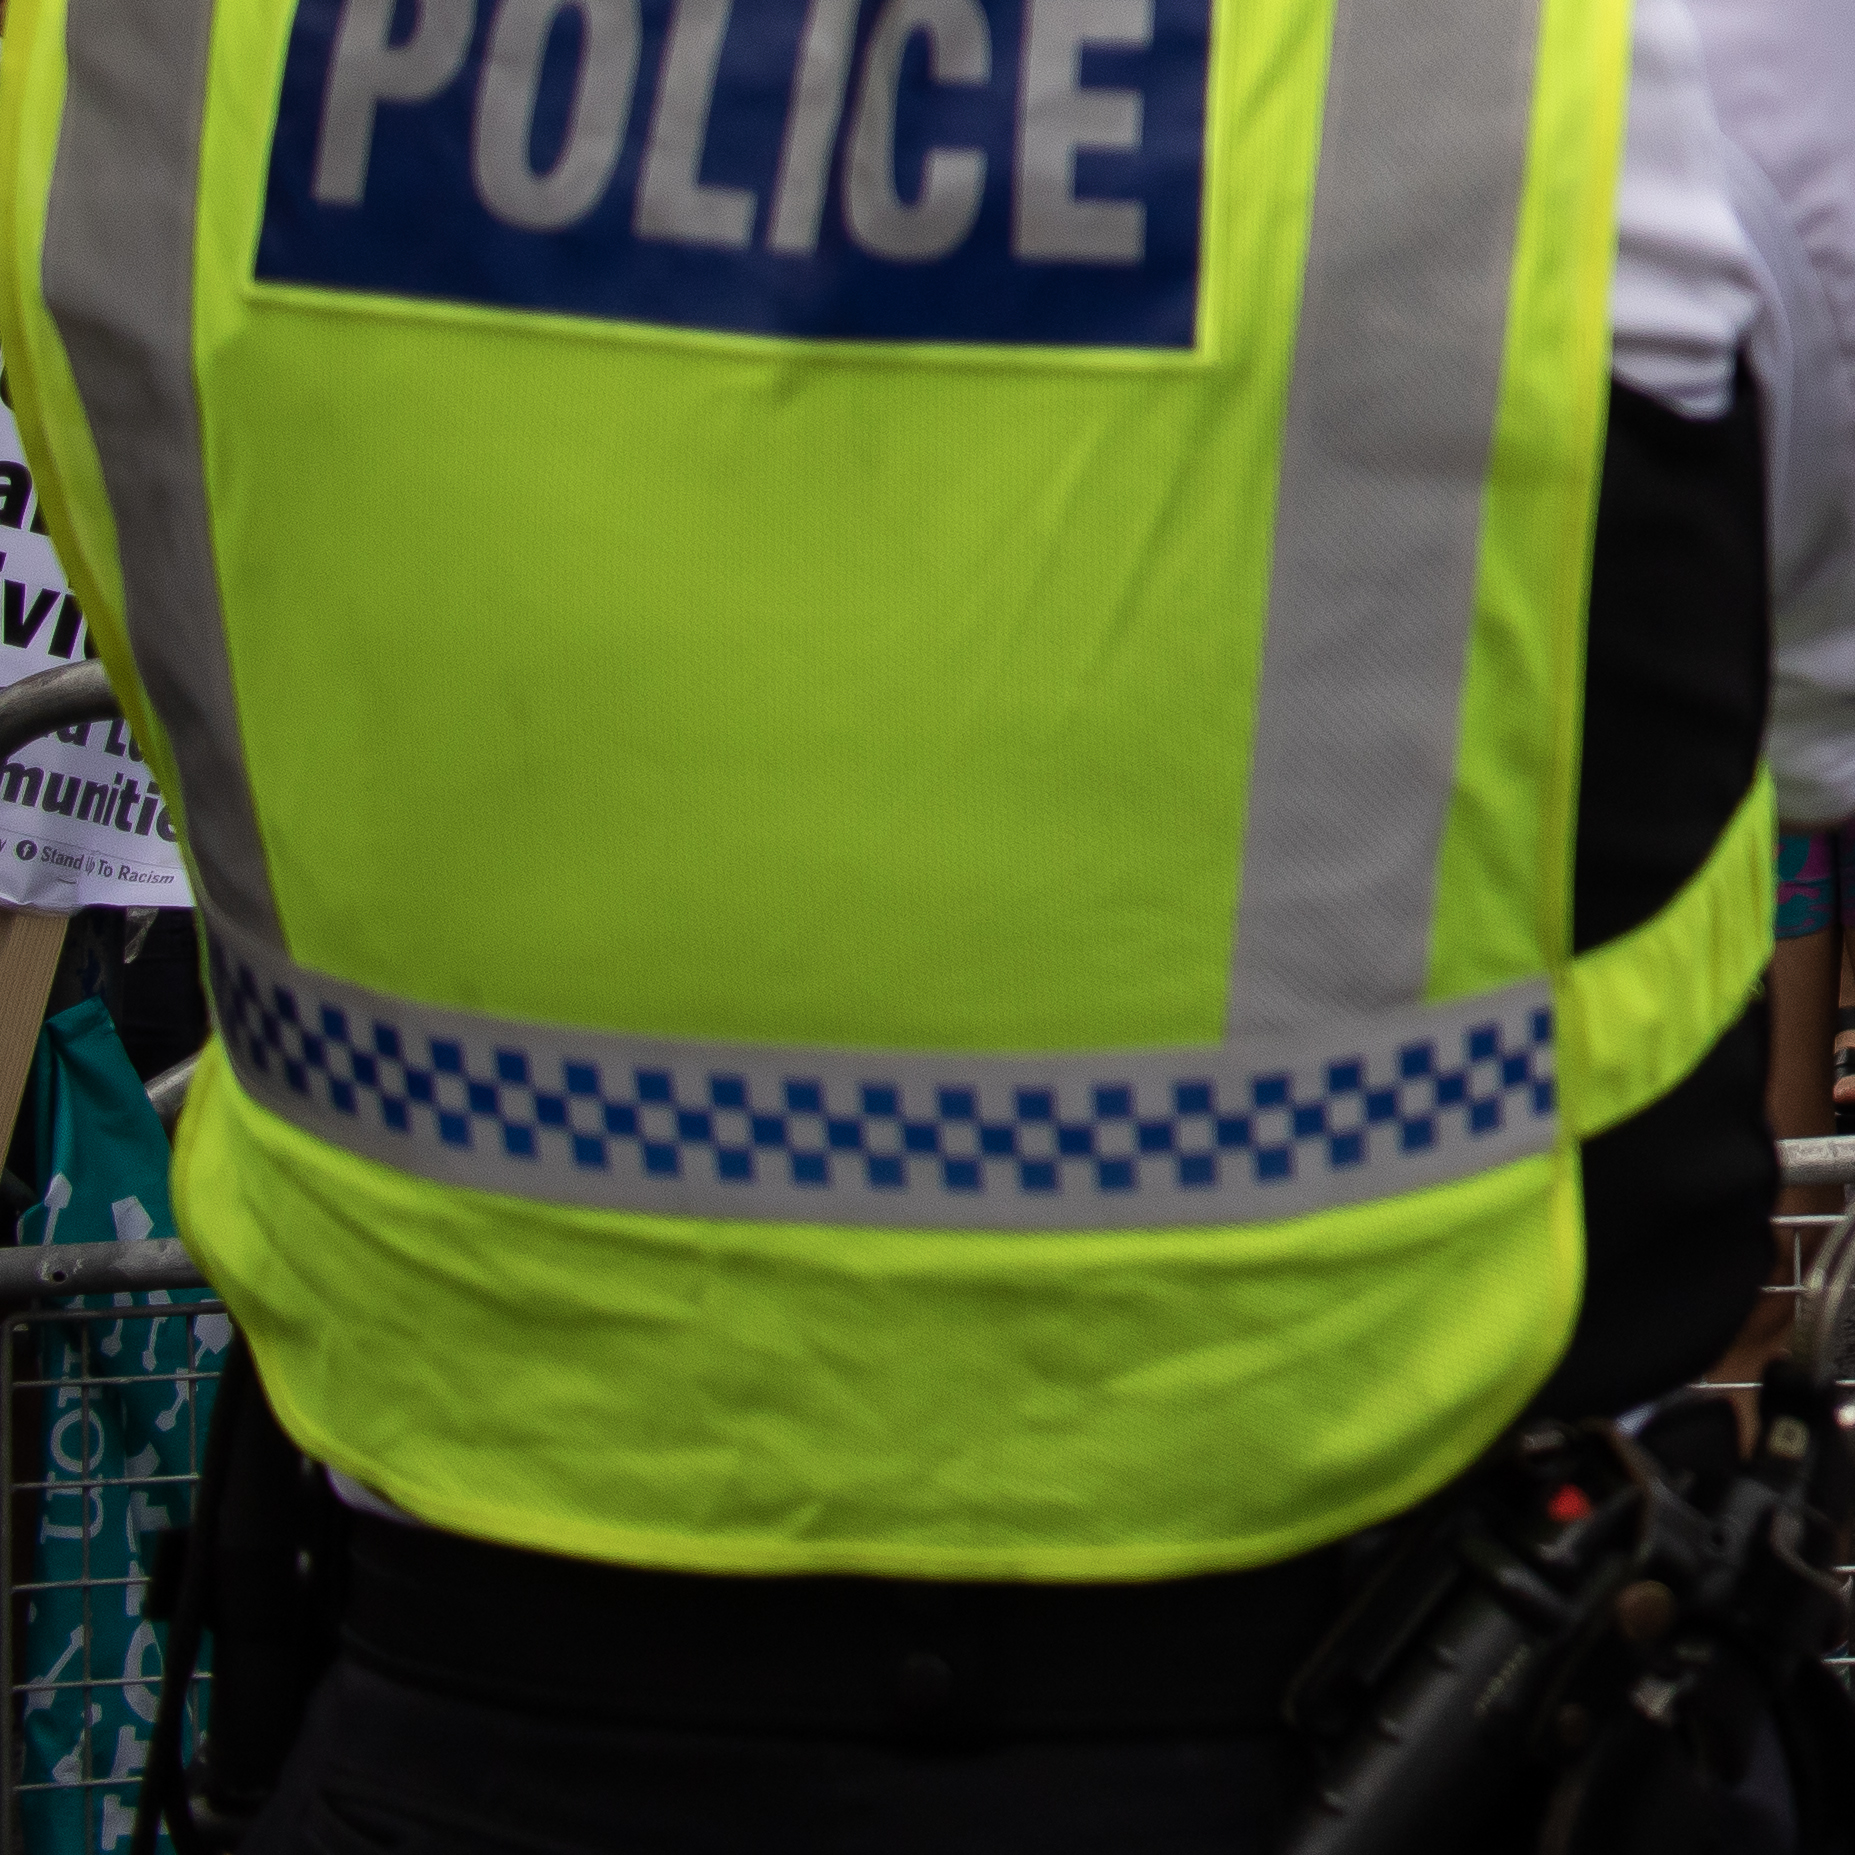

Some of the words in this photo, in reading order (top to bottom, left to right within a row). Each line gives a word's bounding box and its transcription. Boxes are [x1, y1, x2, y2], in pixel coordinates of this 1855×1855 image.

[0, 762, 179, 843] munitie
[41, 846, 85, 870] Stand
[98, 860, 113, 878] To
[118, 865, 175, 884] Racism
